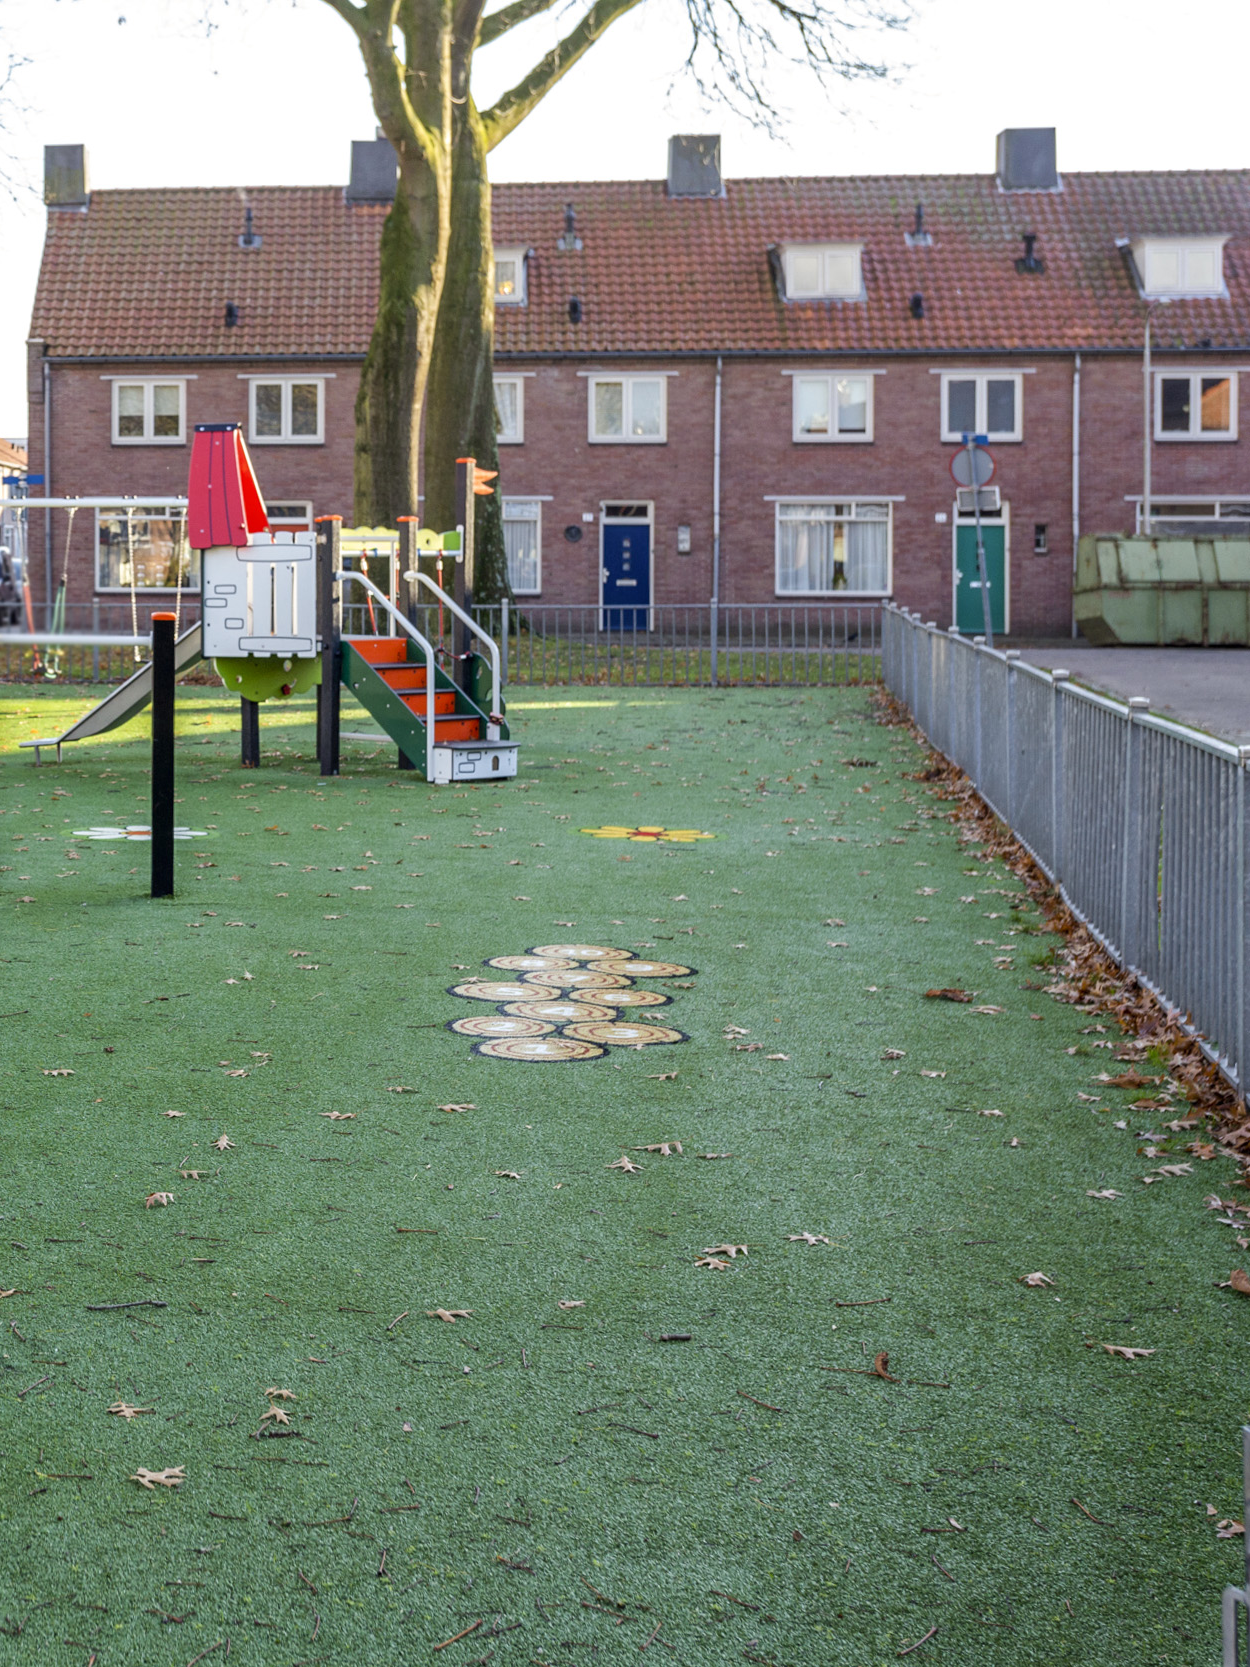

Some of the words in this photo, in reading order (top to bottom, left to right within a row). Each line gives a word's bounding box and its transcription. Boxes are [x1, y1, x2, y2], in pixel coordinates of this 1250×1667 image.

[559, 948, 605, 956] 10
[564, 974, 591, 982] 7
[495, 987, 524, 996] 5
[604, 993, 631, 1002] 6
[539, 1006, 580, 1016] 4
[486, 1021, 516, 1032] 2
[606, 1028, 639, 1039] 3
[525, 1044, 555, 1055] 1
